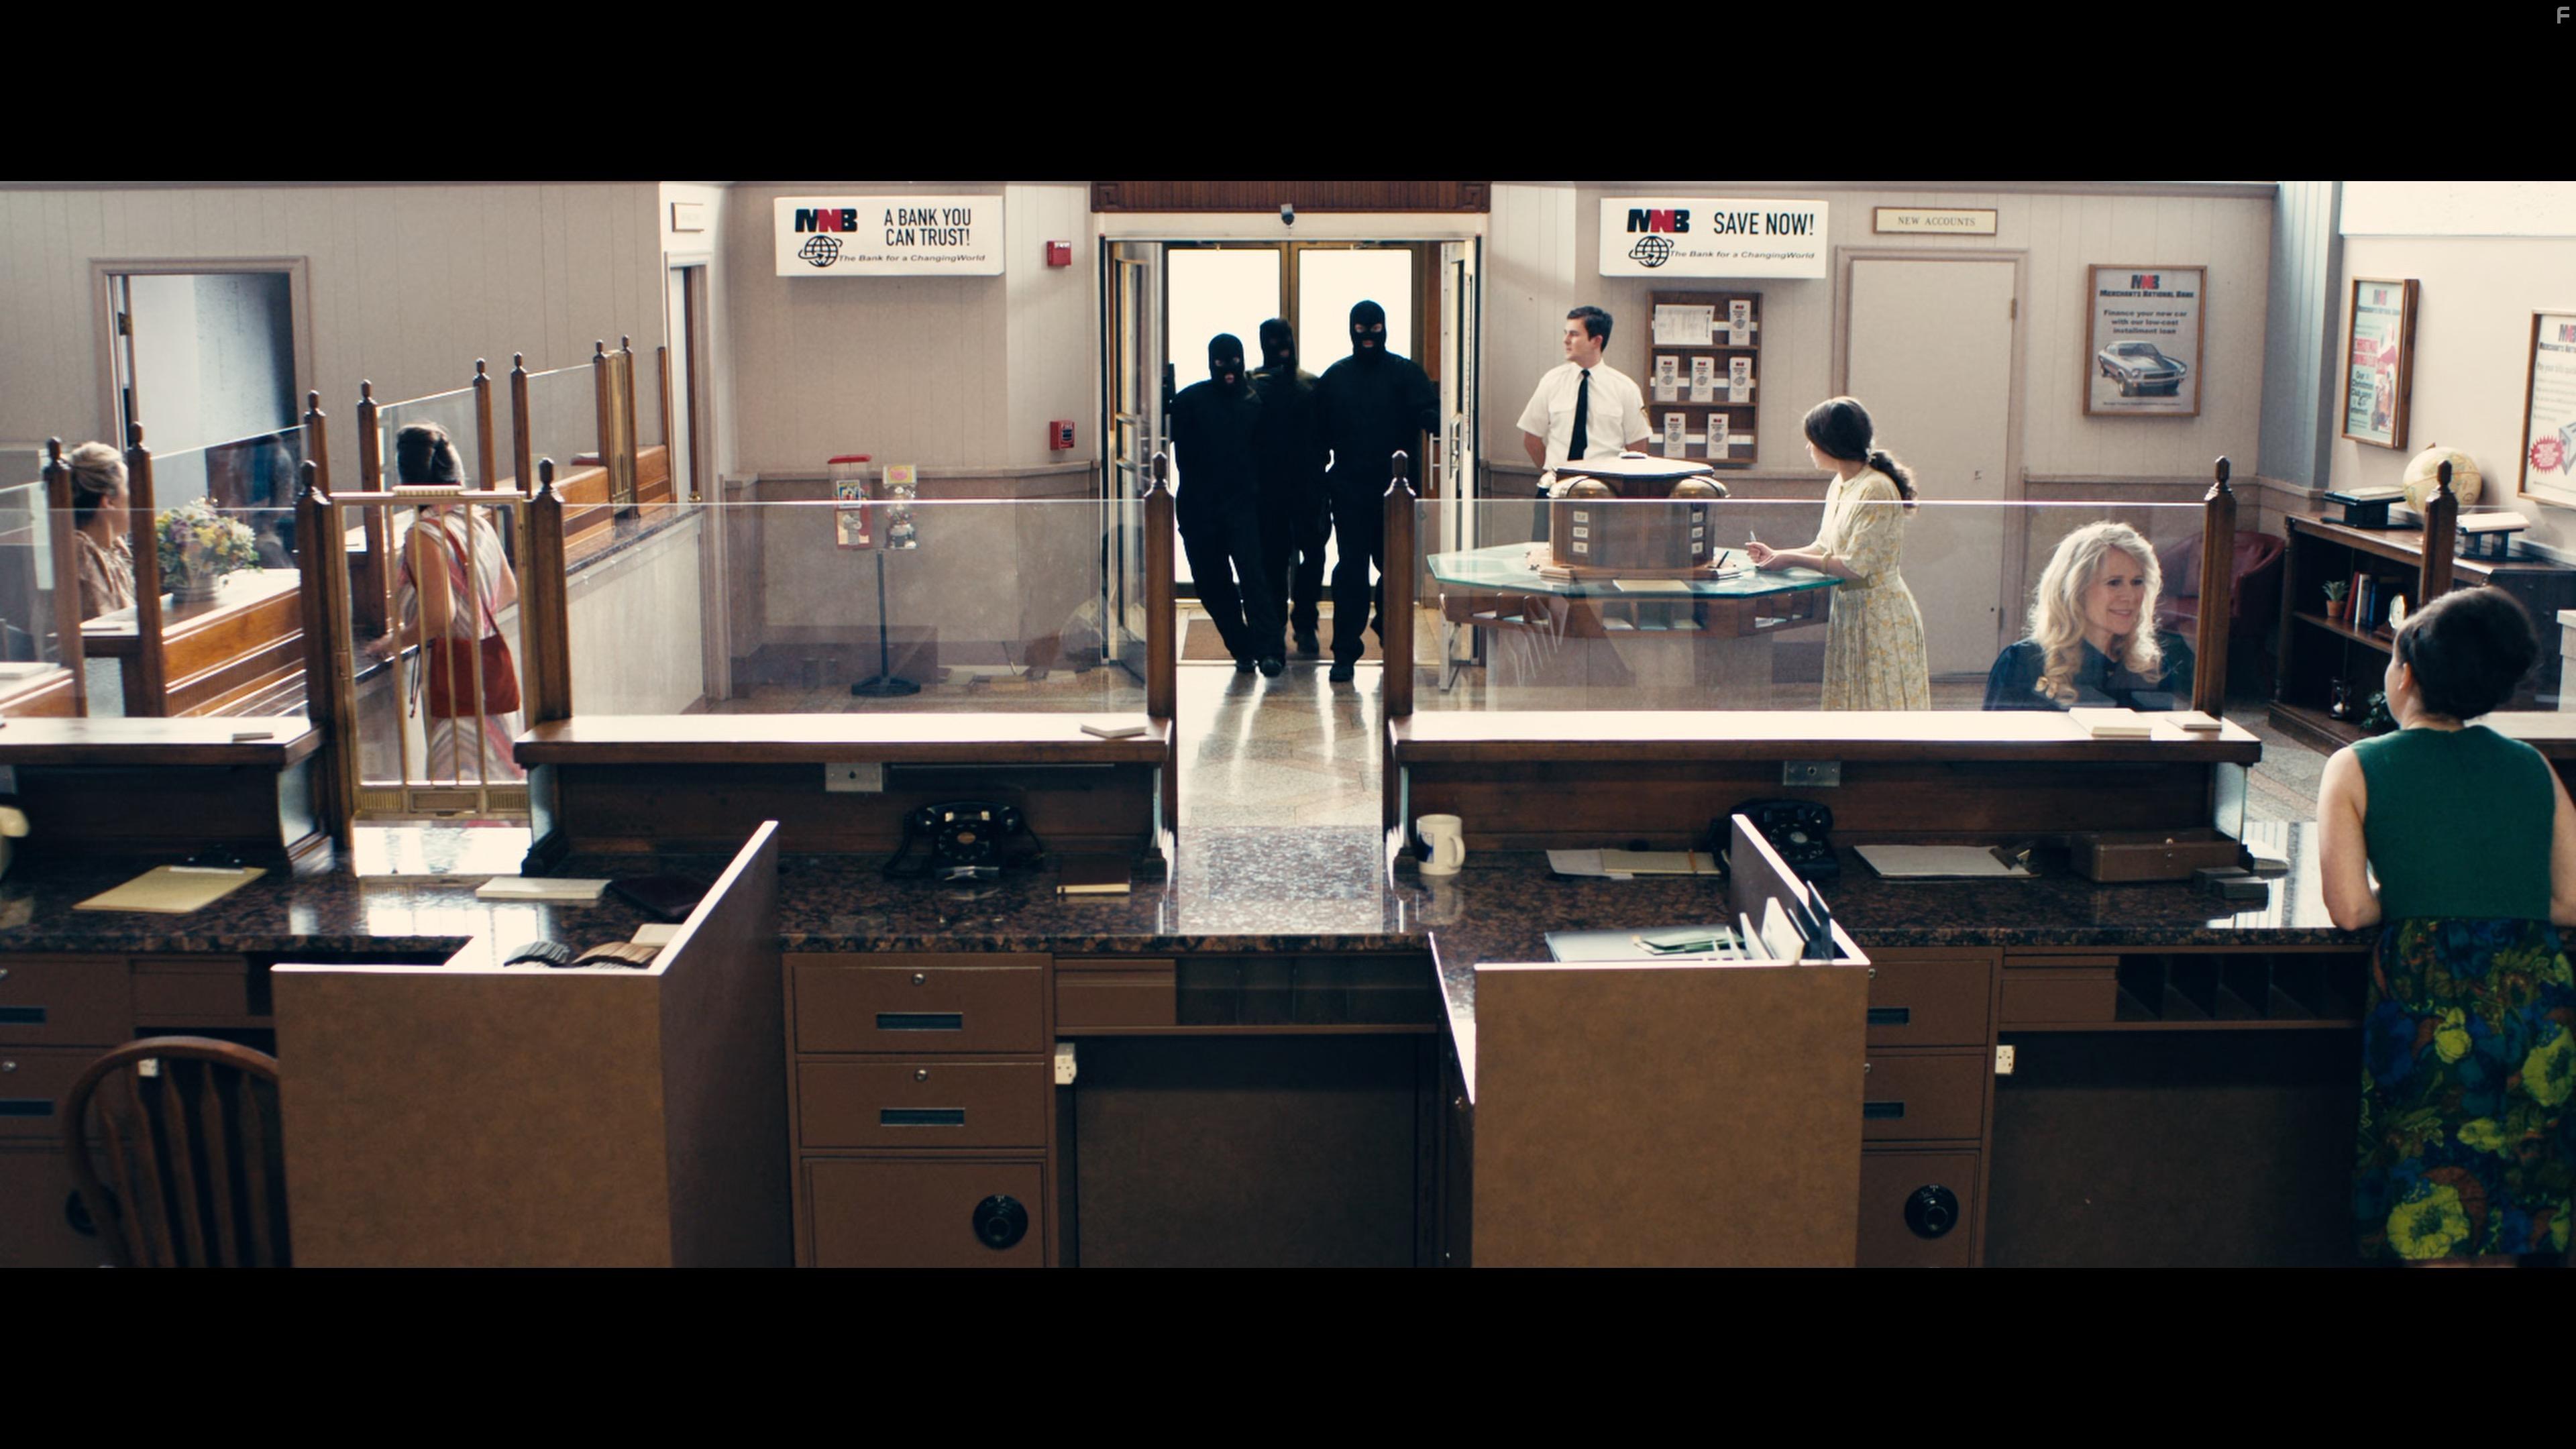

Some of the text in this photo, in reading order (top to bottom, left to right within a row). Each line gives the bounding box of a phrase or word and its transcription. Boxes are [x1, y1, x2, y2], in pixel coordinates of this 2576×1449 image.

[795, 209, 857, 232] MNB
[884, 209, 971, 226] A BANK YOU
[1627, 209, 1690, 233] MNB
[1713, 212, 1814, 235] SAVE NOW!
[1898, 216, 1976, 226] NEW ACCOUNTS
[885, 229, 970, 246] CAN TRUST!
